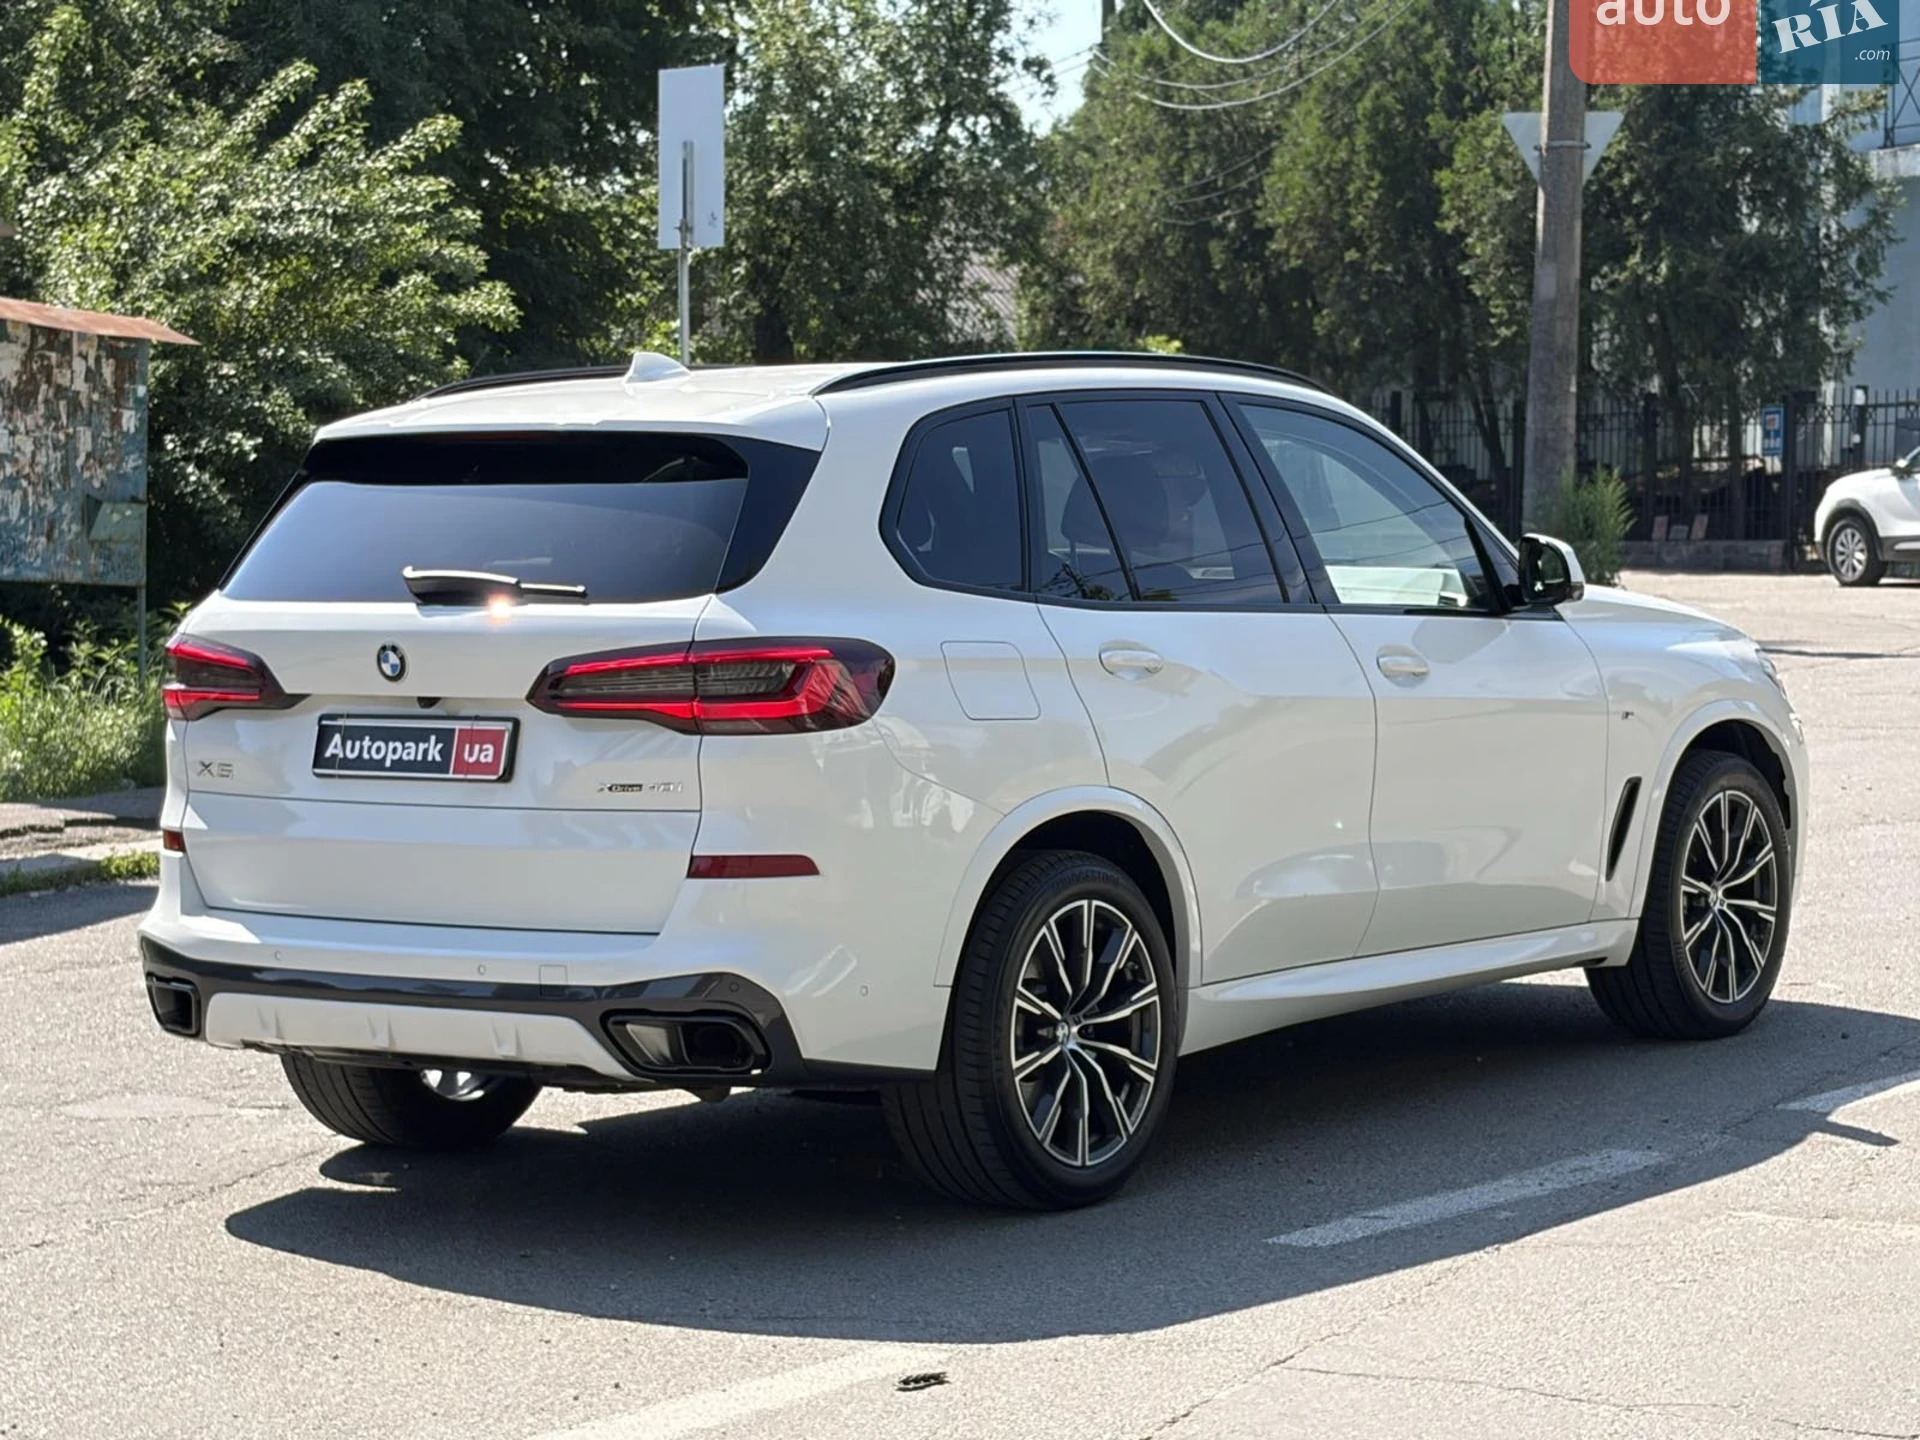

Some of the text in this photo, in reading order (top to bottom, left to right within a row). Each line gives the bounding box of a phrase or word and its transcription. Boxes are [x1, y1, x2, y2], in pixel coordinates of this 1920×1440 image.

[324, 732, 495, 768] Autopark ua
[196, 760, 234, 779] X5
